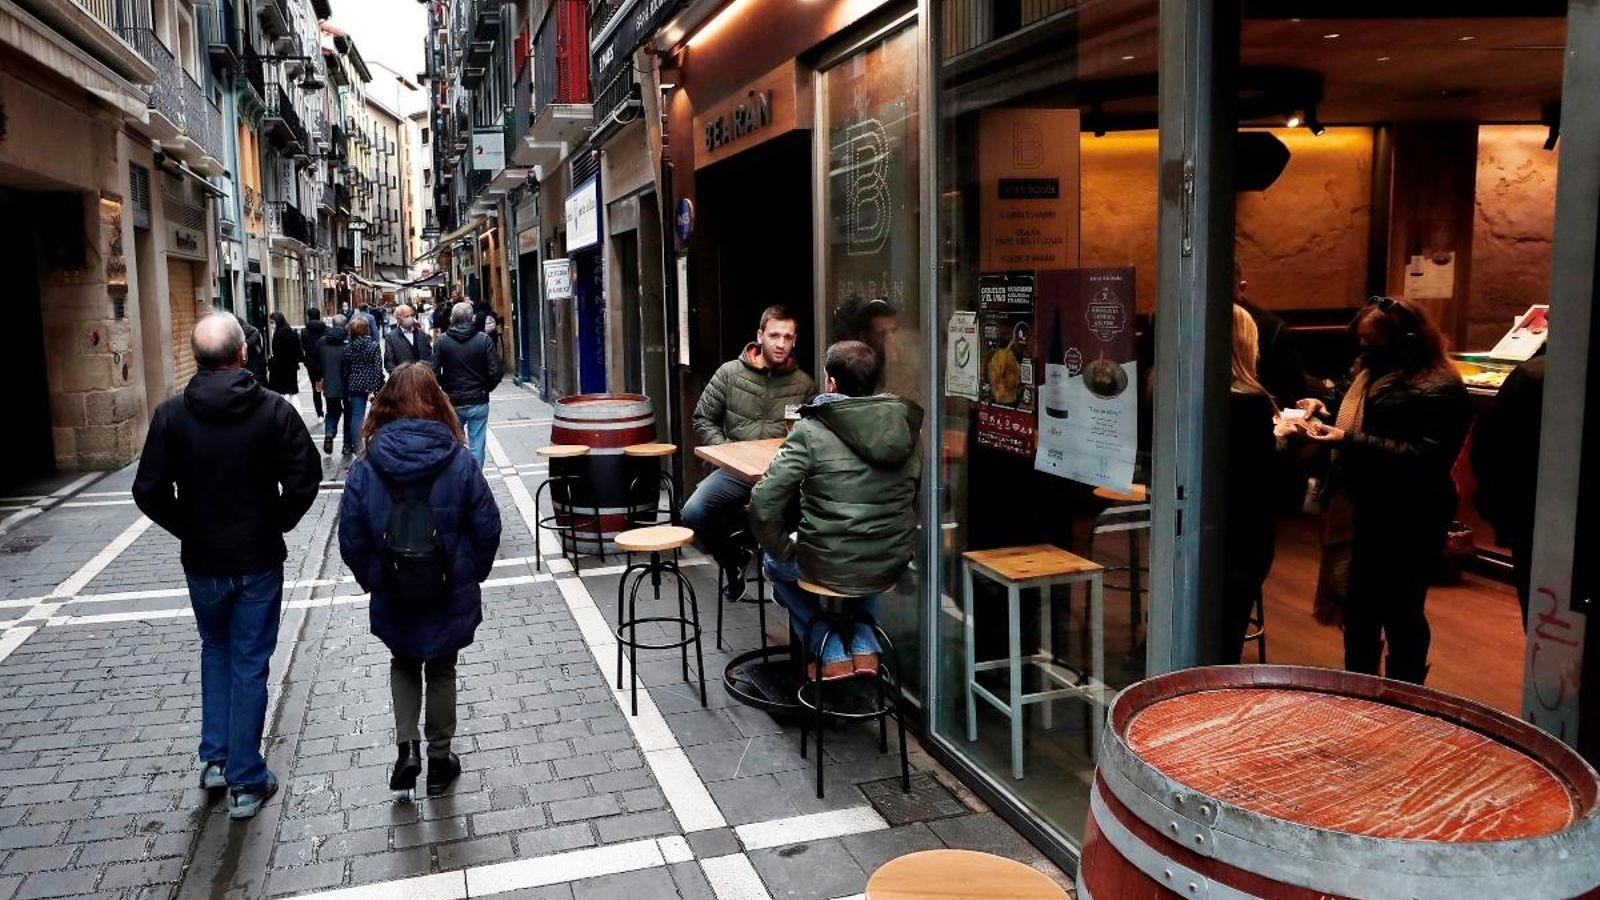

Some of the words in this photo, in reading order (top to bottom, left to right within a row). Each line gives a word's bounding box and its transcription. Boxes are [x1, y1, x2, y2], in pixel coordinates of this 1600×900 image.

[705, 90, 771, 151] BEARÁN
[1013, 123, 1044, 170] B
[846, 118, 891, 256] B
